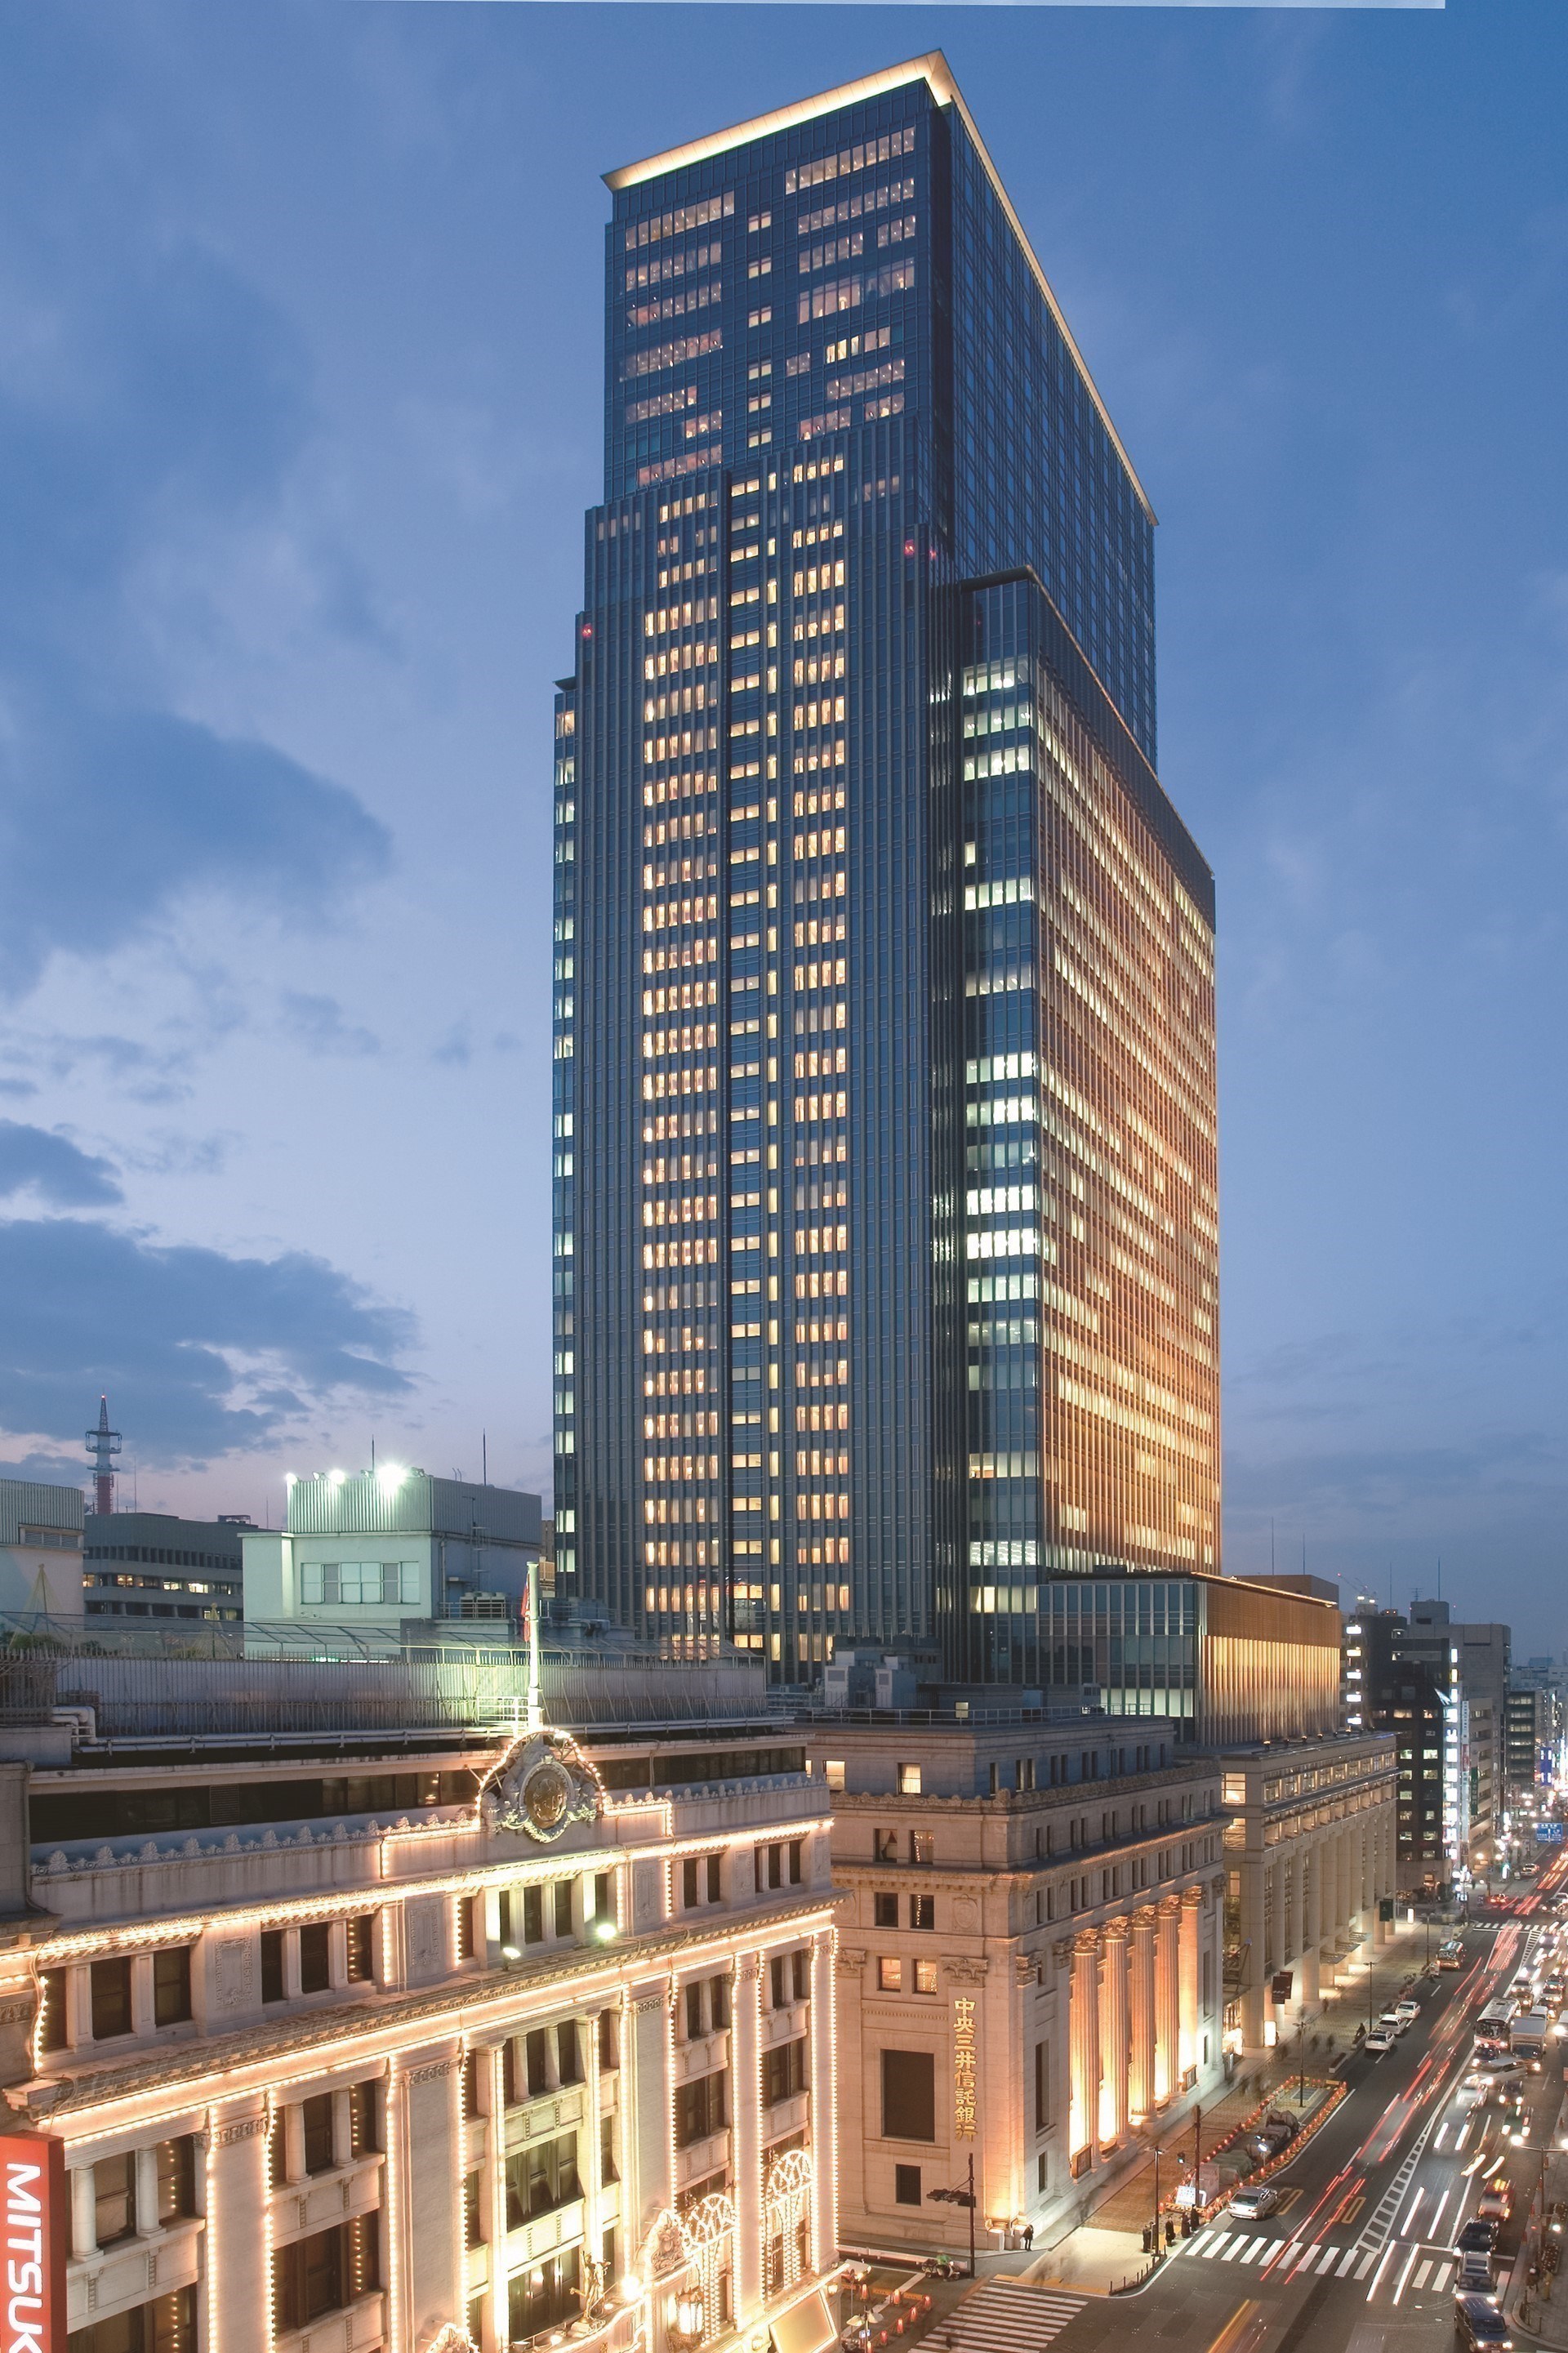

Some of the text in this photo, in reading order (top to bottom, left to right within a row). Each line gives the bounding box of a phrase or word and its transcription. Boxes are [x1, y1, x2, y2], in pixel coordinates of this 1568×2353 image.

[953, 1997, 978, 2143] 中央三井信託銀行
[7, 2163, 42, 2353] MITSUK
